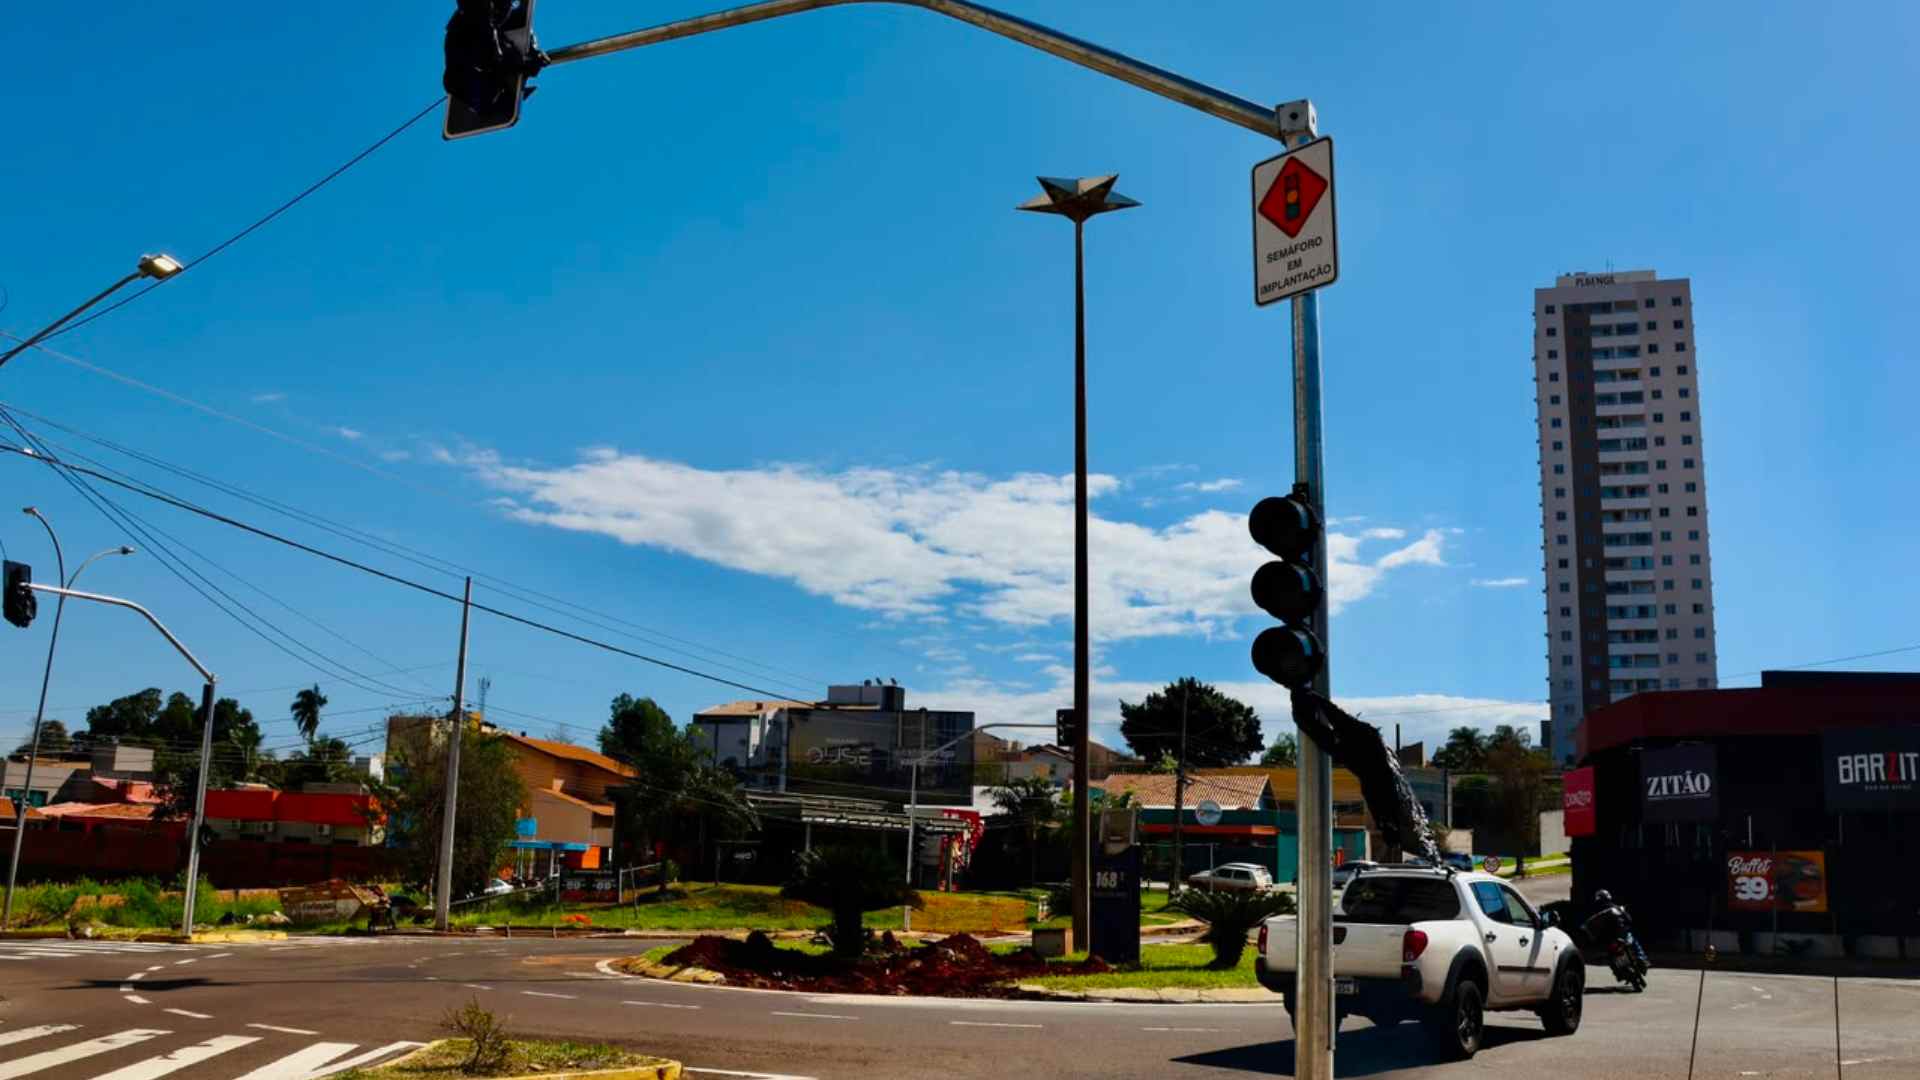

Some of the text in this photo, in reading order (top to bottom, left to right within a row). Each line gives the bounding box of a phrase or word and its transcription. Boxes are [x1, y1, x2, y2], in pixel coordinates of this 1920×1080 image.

[1266, 236, 1322, 263] SEMÁFORO
[1287, 257, 1302, 271] EM
[1260, 264, 1331, 294] IMPLANTAÇÃO
[1646, 770, 1711, 797] ZITÃO
[1728, 855, 1773, 876] Buffet
[1734, 876, 1769, 900] 39
